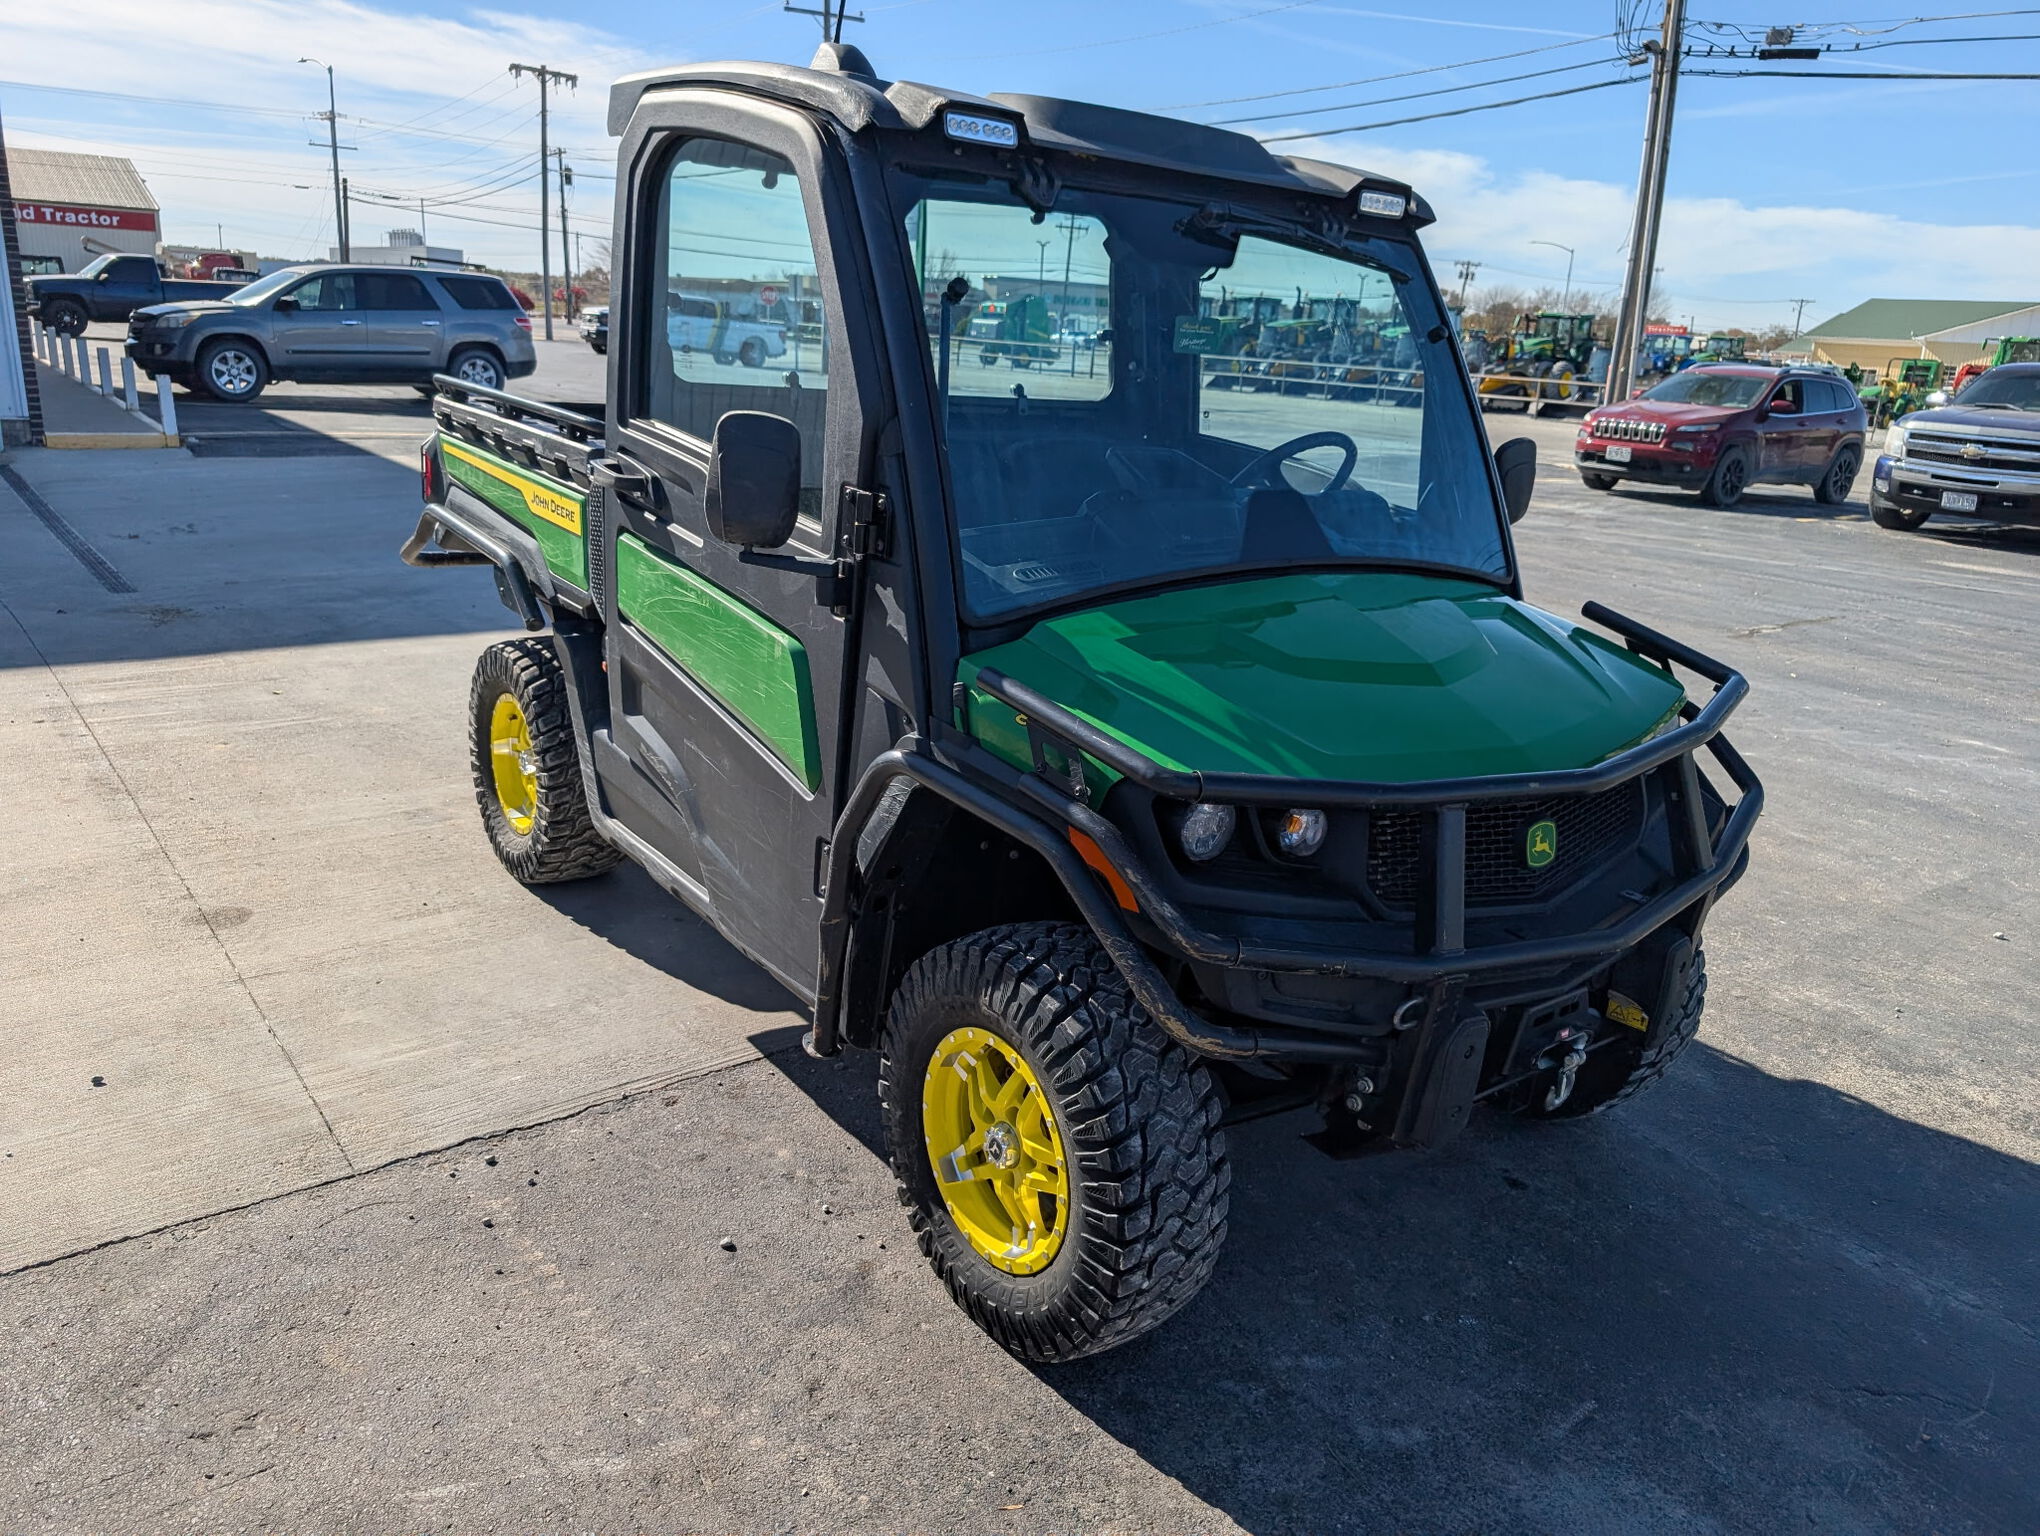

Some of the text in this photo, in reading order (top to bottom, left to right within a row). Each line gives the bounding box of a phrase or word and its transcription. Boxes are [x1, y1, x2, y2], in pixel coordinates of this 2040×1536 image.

[41, 207, 120, 226] Tractor
[532, 491, 575, 523] JOHN DEERE
